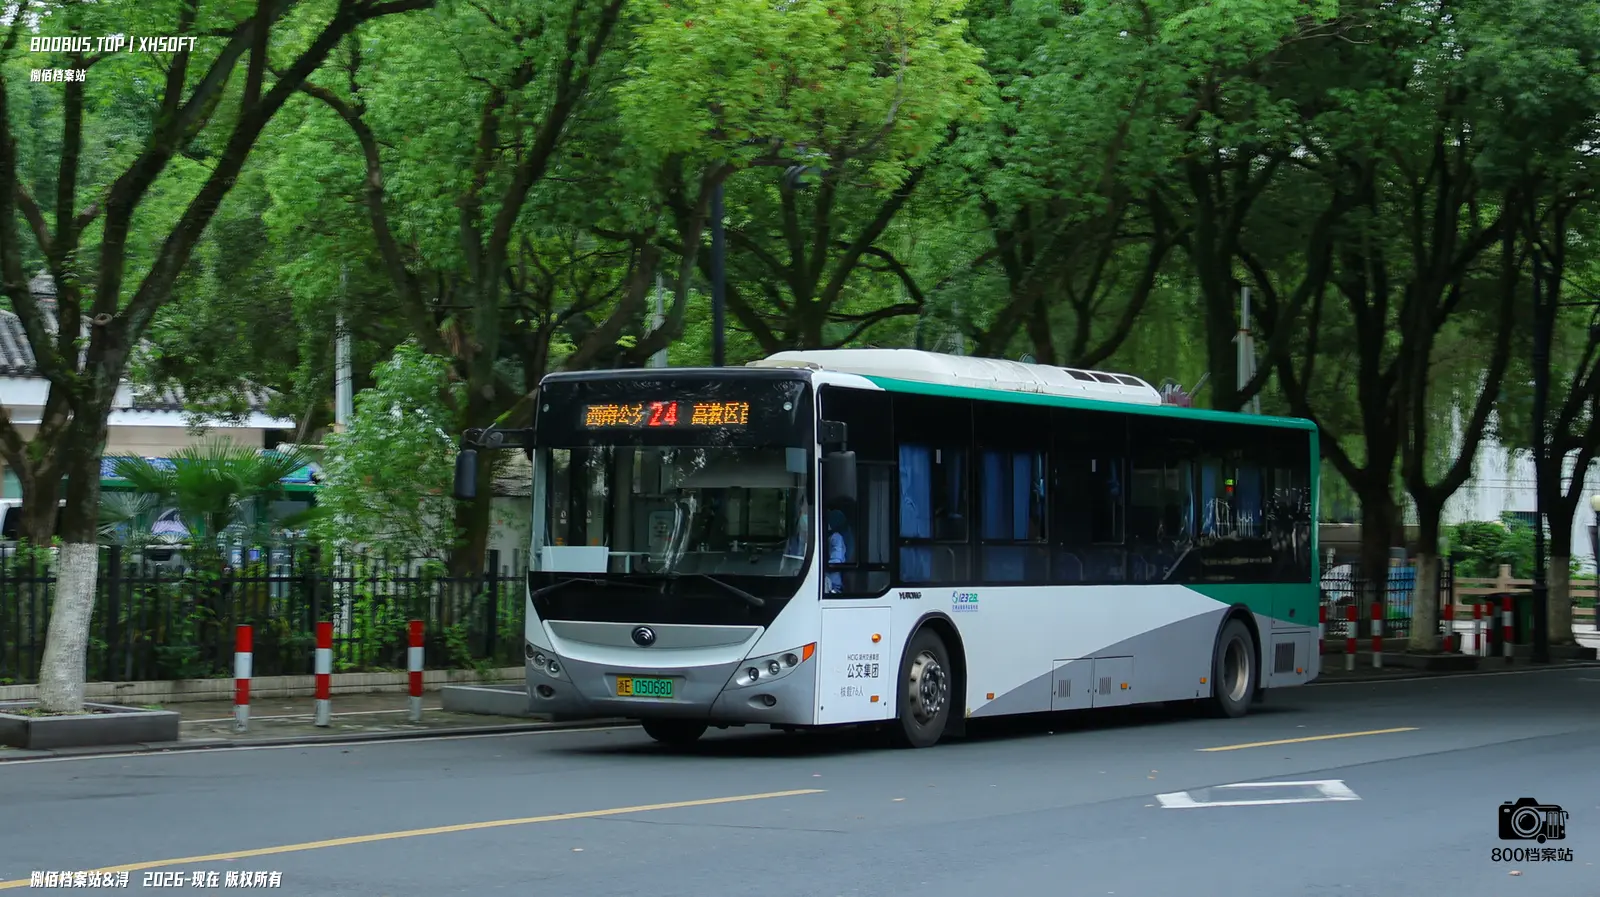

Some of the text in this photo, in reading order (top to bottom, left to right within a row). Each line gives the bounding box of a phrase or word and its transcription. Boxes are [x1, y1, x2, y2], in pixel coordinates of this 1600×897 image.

[649, 402, 677, 426] 24
[847, 663, 879, 678] 公交集团
